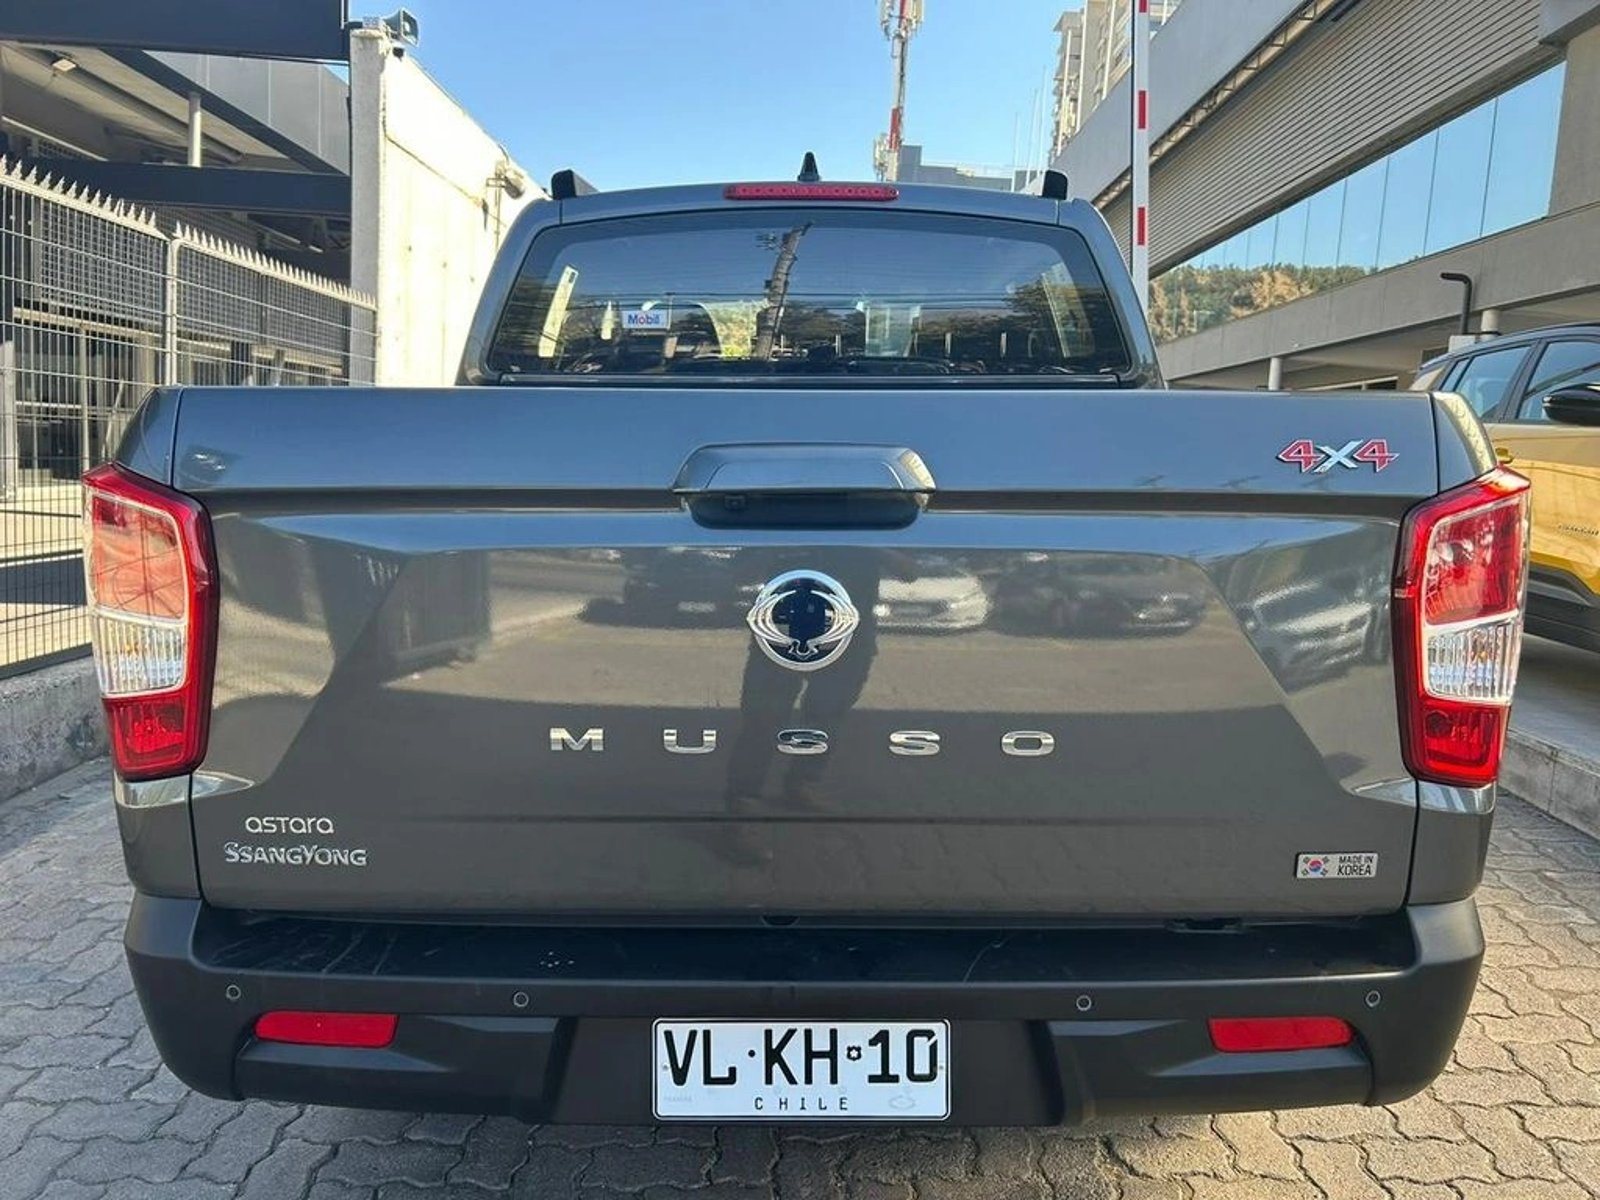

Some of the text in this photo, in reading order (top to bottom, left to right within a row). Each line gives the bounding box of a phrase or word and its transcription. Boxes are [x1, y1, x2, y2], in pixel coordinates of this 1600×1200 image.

[627, 313, 661, 325] Mobil
[549, 727, 1055, 757] MUSSO
[245, 816, 334, 834] astara
[1339, 856, 1374, 864] MADE IN
[1337, 864, 1371, 876] KOREA
[754, 1097, 849, 1111] CHILE
